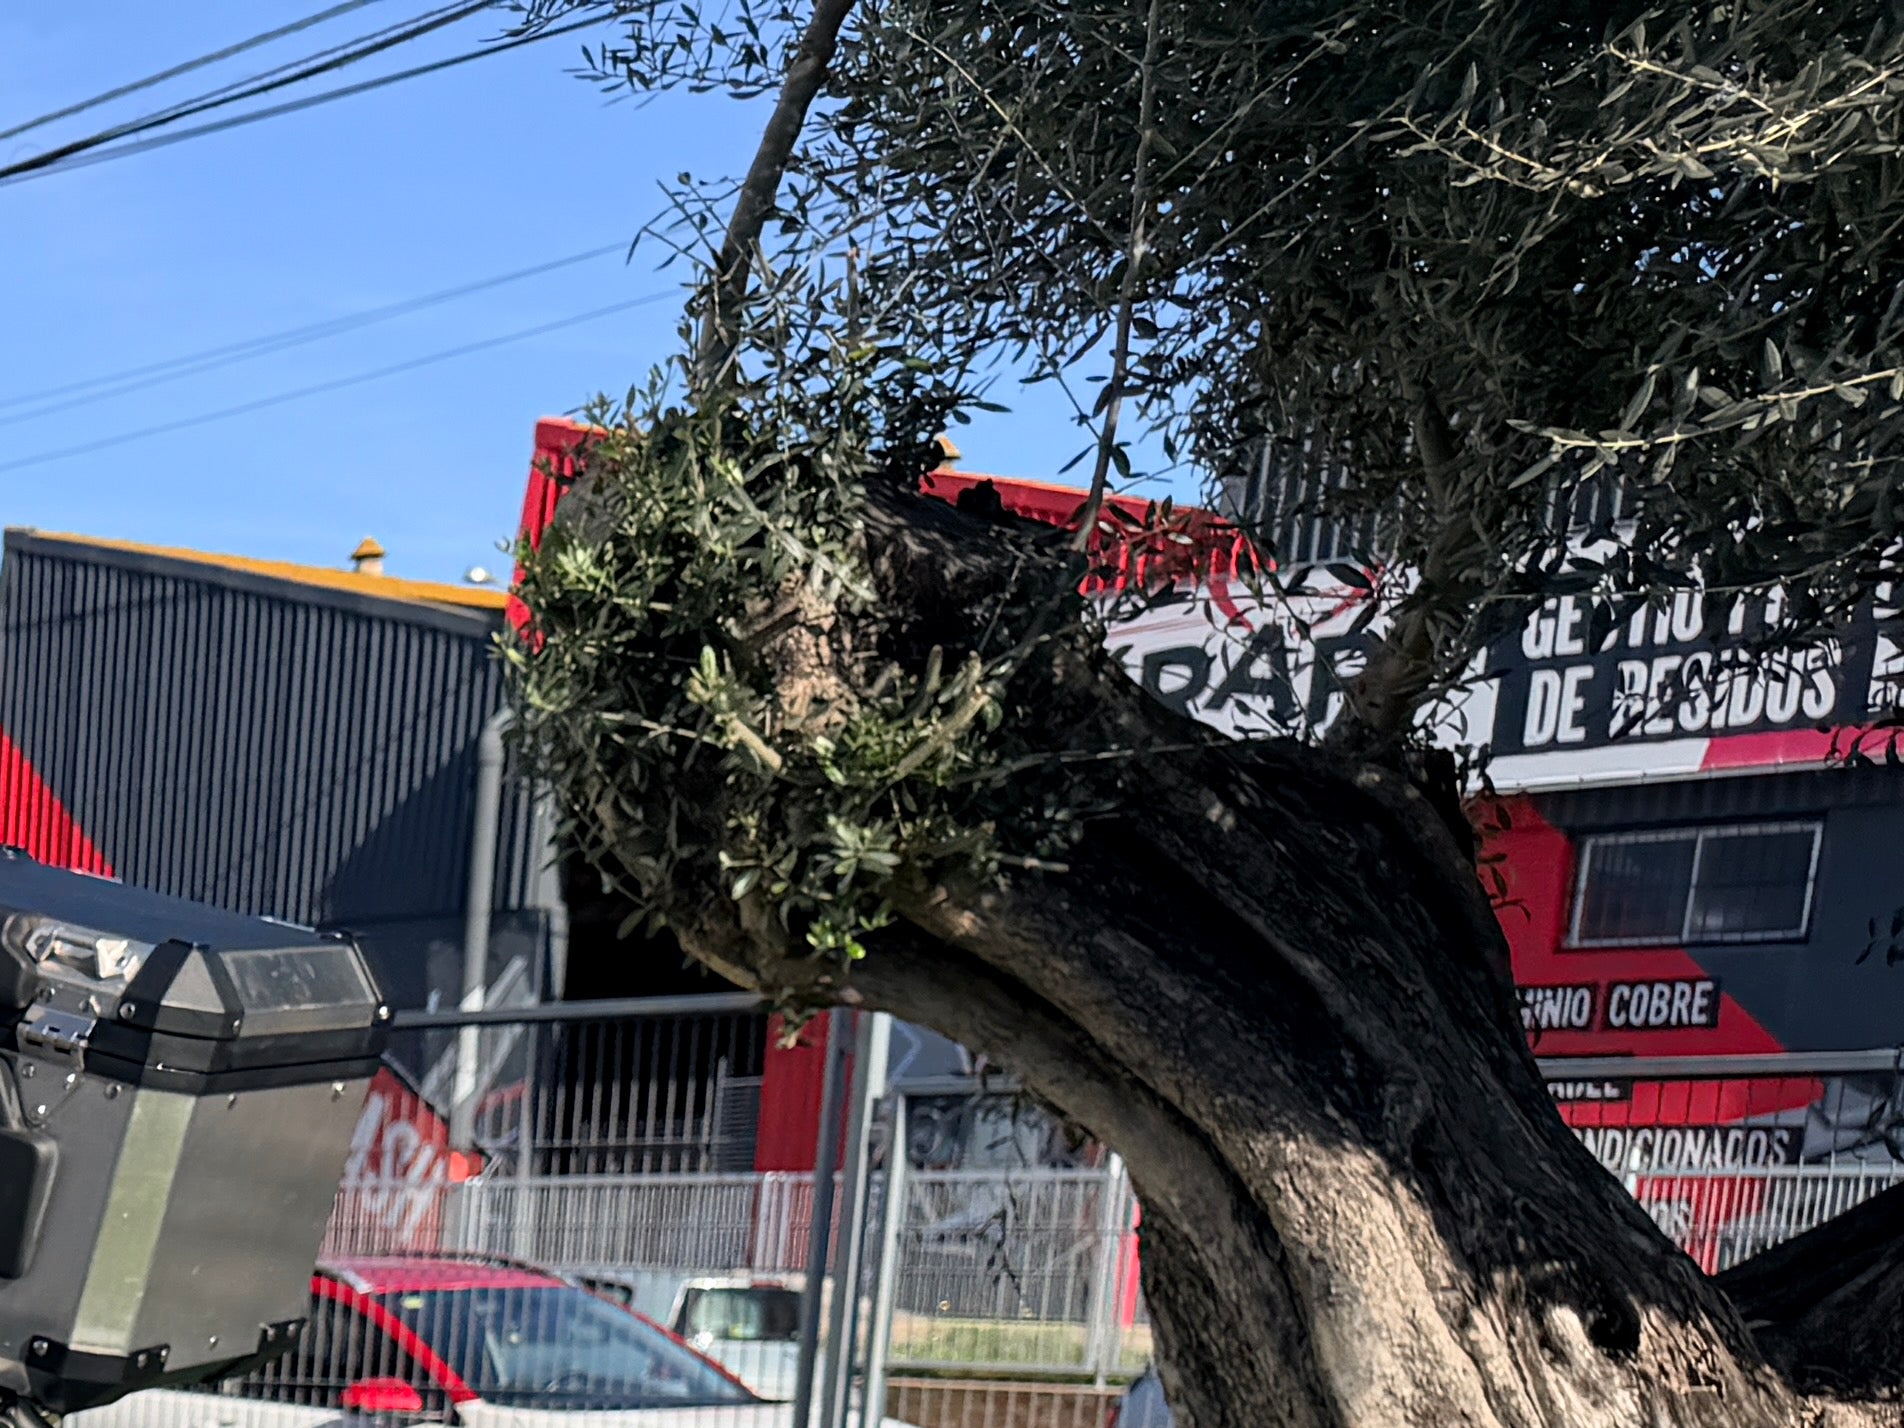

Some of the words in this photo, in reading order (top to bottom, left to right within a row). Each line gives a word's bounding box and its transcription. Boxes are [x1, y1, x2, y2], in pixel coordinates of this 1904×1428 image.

[1523, 665, 1594, 747] DE
[1608, 981, 1714, 1027] COBRE
[1574, 1127, 1791, 1172] NDICIONADOS
